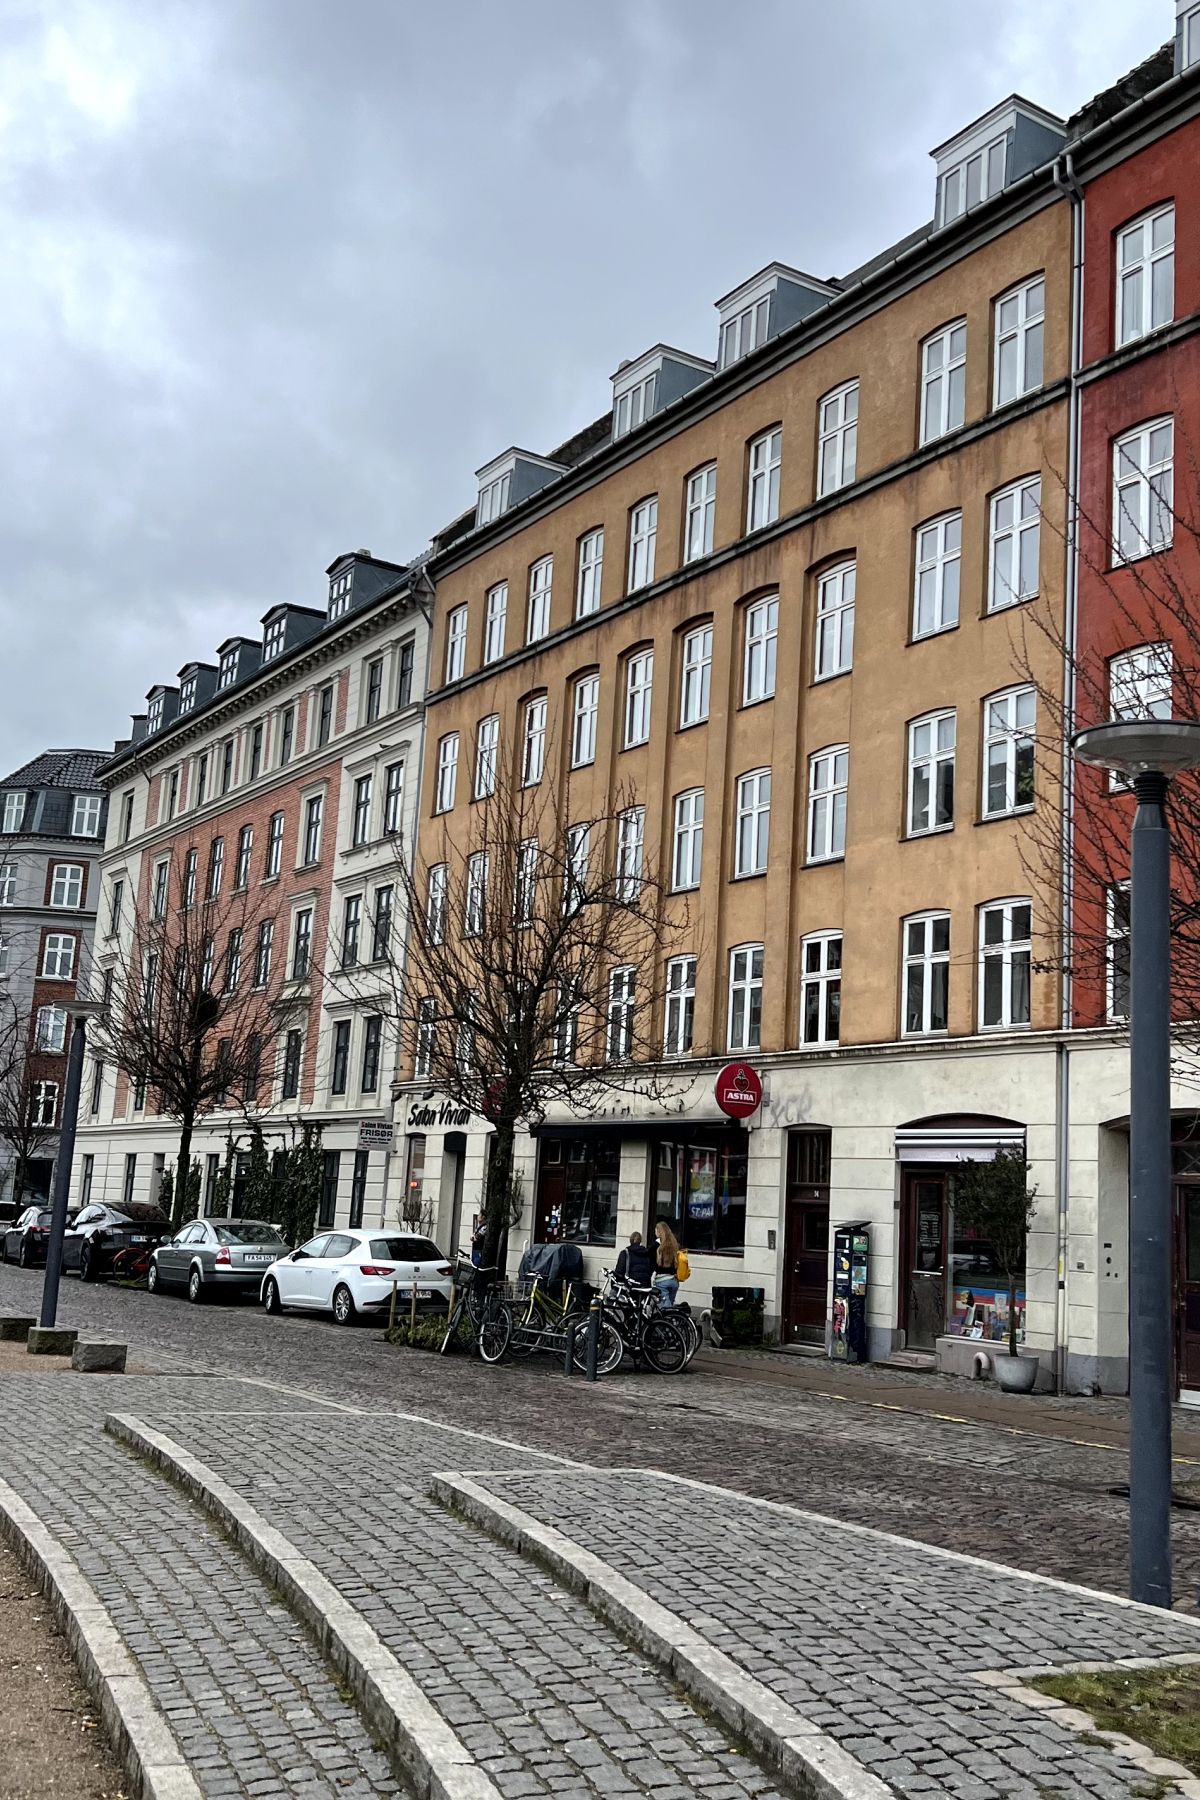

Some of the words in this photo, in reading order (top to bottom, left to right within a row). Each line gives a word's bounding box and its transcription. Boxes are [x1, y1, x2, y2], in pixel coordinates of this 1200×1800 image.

[727, 1092, 754, 1101] ASTRA
[408, 1103, 436, 1126] Salon
[439, 1099, 470, 1126] Vivian
